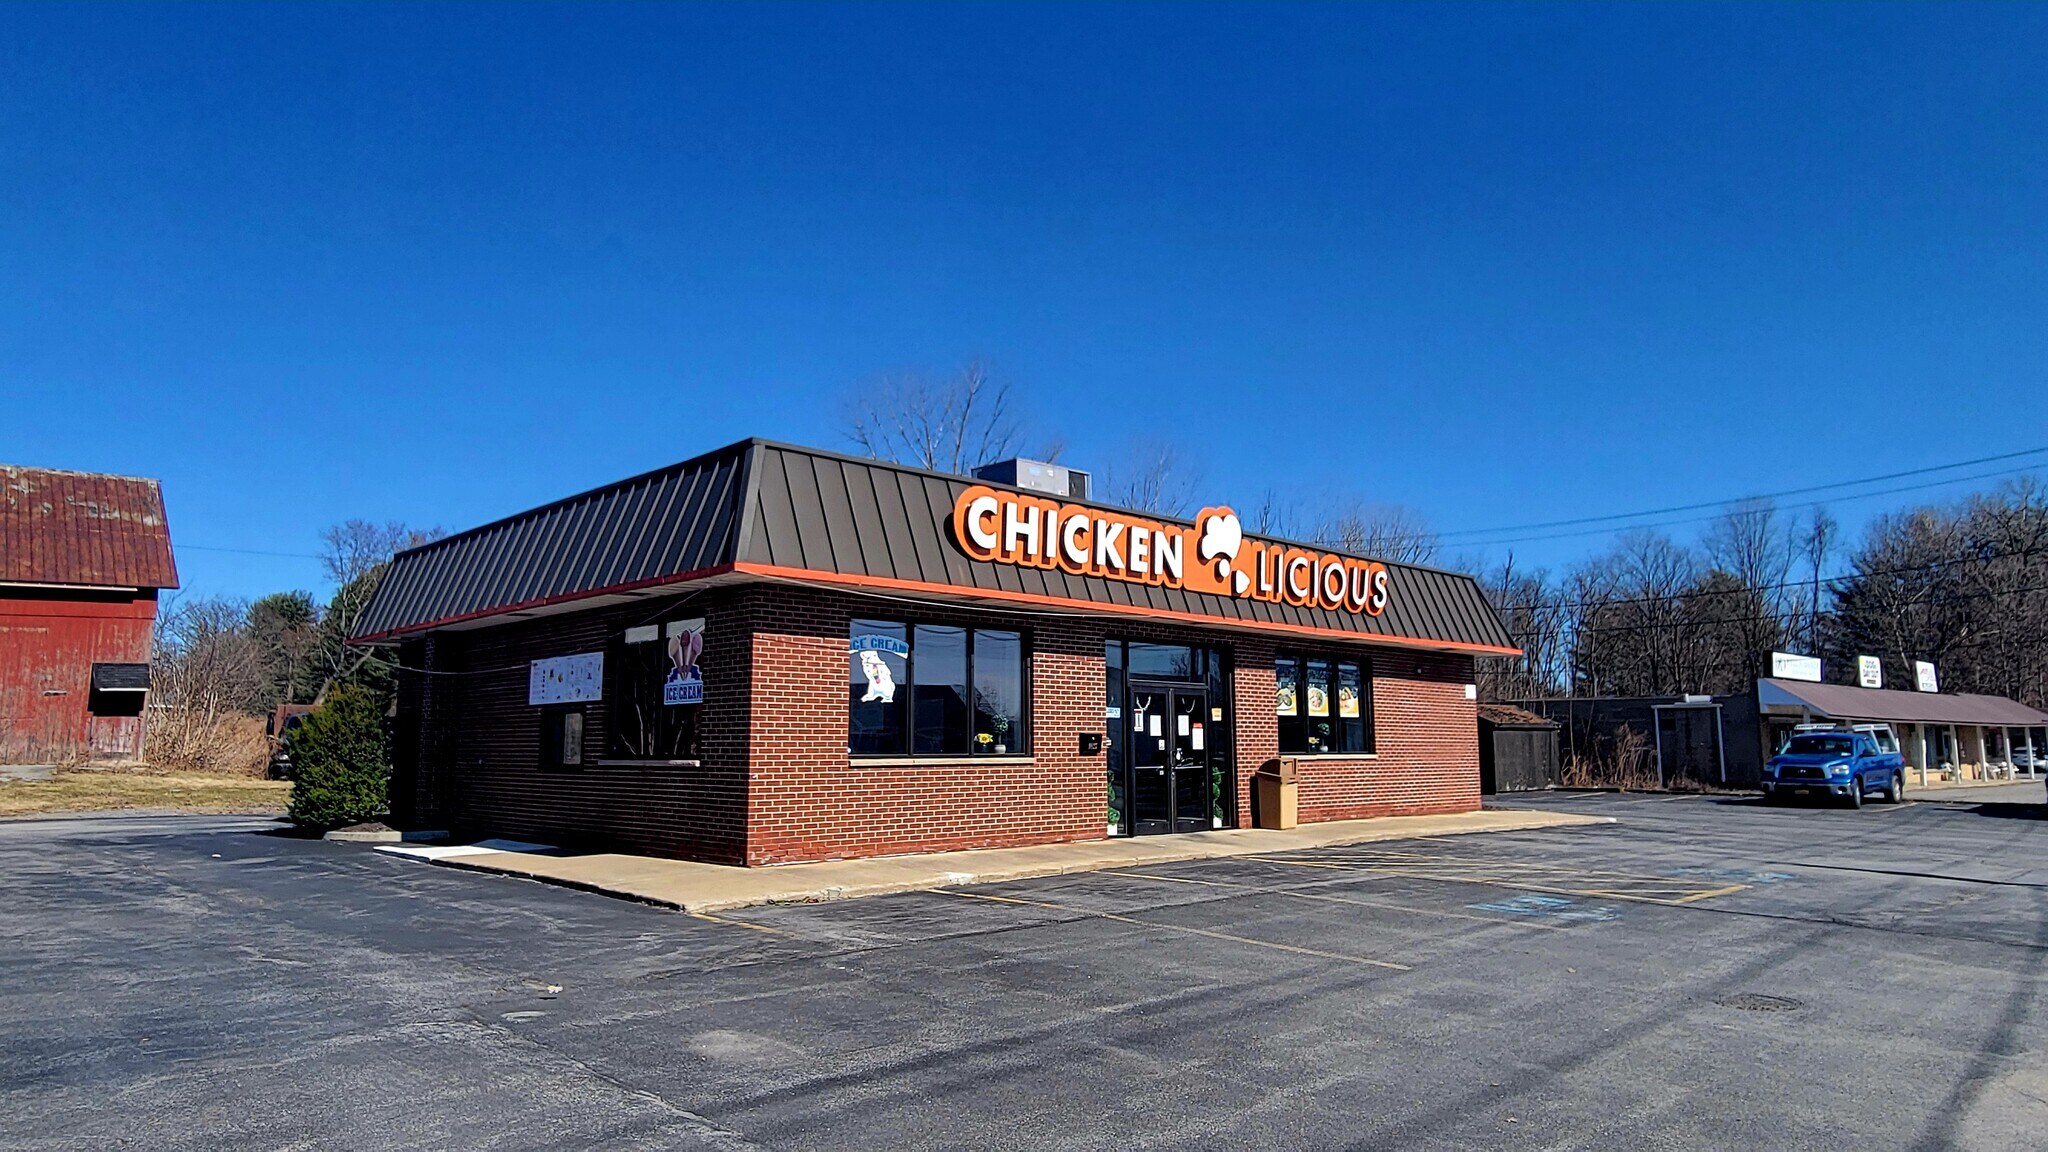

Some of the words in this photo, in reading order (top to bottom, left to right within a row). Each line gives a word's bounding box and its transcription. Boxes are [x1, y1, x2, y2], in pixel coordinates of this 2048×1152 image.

[967, 496, 1183, 579] CHICKEN
[1260, 550, 1388, 609] LICIOUS
[666, 686, 678, 701] ICE
[679, 684, 703, 700] CREAM
